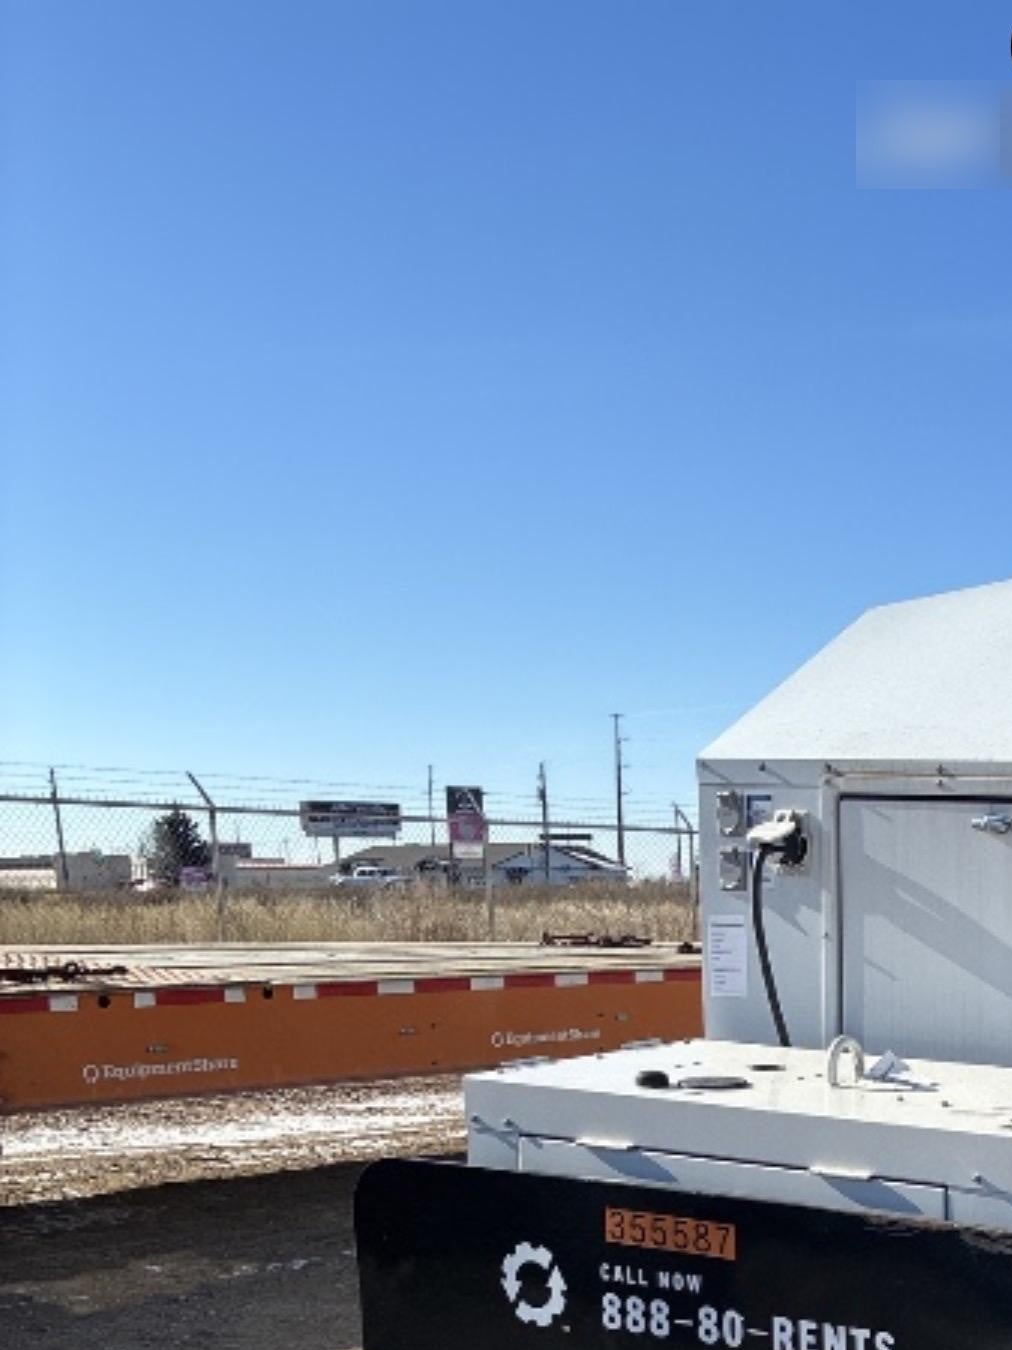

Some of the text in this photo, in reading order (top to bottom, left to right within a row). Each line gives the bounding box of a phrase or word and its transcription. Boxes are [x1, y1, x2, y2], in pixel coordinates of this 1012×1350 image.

[608, 1211, 730, 1255] 355587
[600, 1262, 702, 1294] CALL NOW
